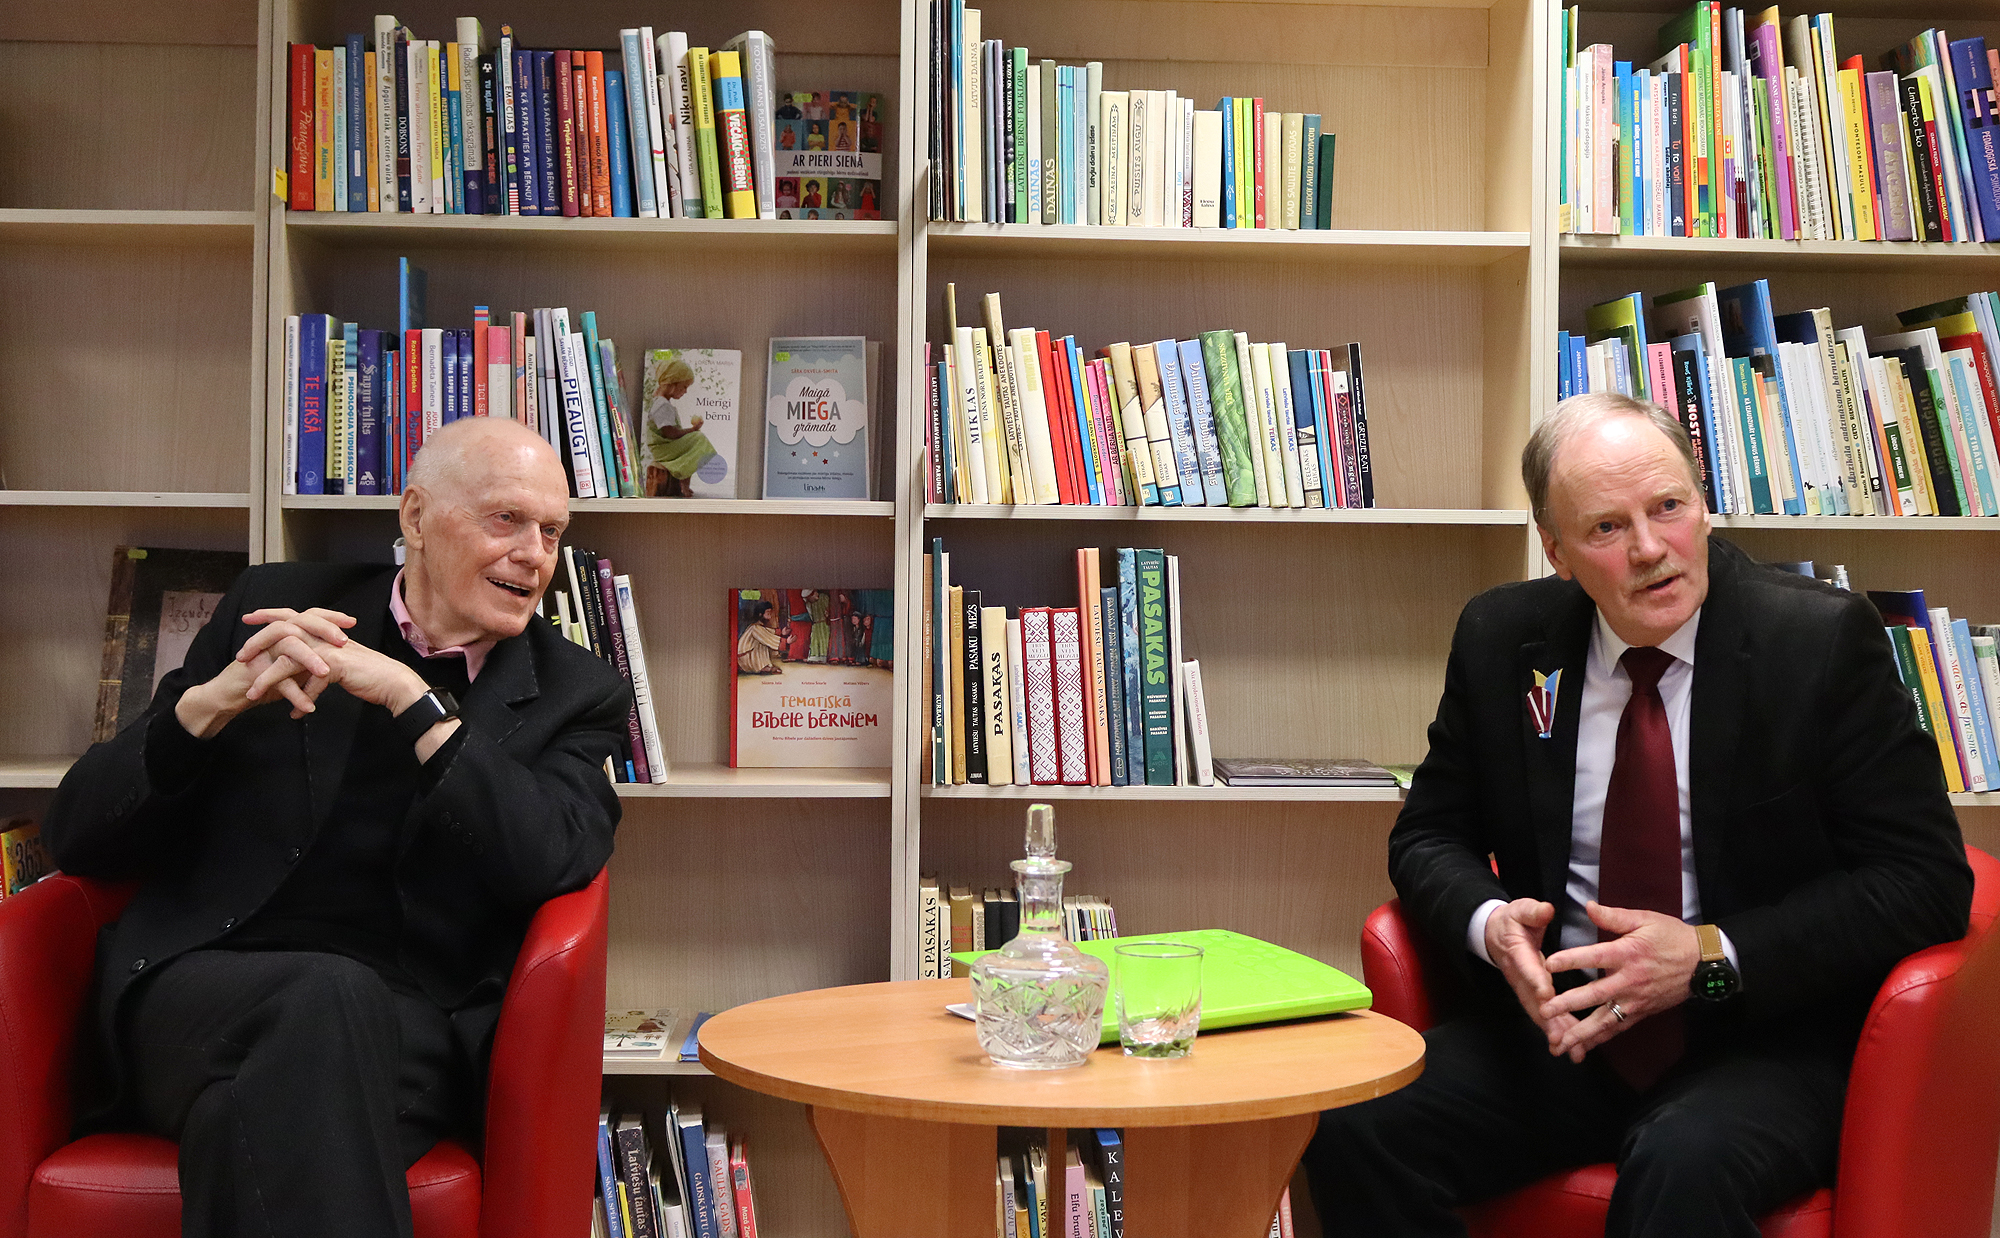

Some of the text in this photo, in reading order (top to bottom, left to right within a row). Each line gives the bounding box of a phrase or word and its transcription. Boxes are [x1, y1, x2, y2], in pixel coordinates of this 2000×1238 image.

[630, 56, 641, 84] DOMĀ
[754, 58, 763, 82] DOMĀ
[970, 42, 978, 71] DAINAS
[464, 48, 476, 167] Radošas personības rokasgrāmata
[632, 84, 641, 108] MANS
[677, 66, 691, 125] Niķu nav!
[756, 84, 764, 106] MANS
[521, 106, 530, 154] SAPRASTIES
[543, 107, 553, 154] SAPRASTIES
[634, 110, 645, 138] BĒRNS?
[756, 109, 767, 152] PUSAUDZIS?
[1015, 69, 1025, 193] LATVIEŠU BĒRNU FOLKLORA
[1907, 86, 1924, 148] Umberto Eko
[398, 116, 408, 154] DOBSONS
[729, 114, 747, 188] VECĀKI BĒRNI
[1982, 130, 1998, 172] PEDAGOĢISKĀ
[385, 162, 393, 184] vairāk
[522, 156, 530, 168] AR
[546, 156, 554, 168] AR
[792, 154, 864, 168] AR PIERI SIENĀ
[1620, 145, 1630, 204] DZIRKSTS
[1672, 140, 1682, 185] Tu to vari!
[1854, 123, 1866, 194] MONTESORI MAZULIS
[524, 170, 533, 201] BĒRNU?
[546, 170, 556, 202] BĒRNU?
[1030, 159, 1040, 212] DAINAS
[1045, 158, 1056, 215] DAINAS
[1287, 166, 1296, 198] SAULĪTE
[1286, 200, 1295, 217] KAD
[1614, 346, 1622, 372] JESPERS
[304, 376, 320, 394] TE,
[478, 383, 486, 400] TICI
[798, 386, 830, 403] Maigā
[932, 377, 940, 406] LATVIEŠU
[996, 344, 1016, 441] LATVIEŠU TAUTAS ANEKDOTES
[304, 396, 322, 433] IEKŠĀ
[346, 376, 354, 430] PSIHOLOĢIJA
[564, 378, 587, 458] PIEAUGT
[696, 397, 732, 410] Mierīgi
[705, 411, 731, 421] bērni
[788, 402, 841, 420] MIEGA
[1686, 404, 1700, 437] NOST
[793, 422, 837, 438] grāmata
[1268, 428, 1276, 452] TEIKAS
[1287, 428, 1295, 452] TEIKAS
[1962, 405, 1984, 470] MAZAIS TIRĀNS
[1360, 454, 1368, 474] RATI
[608, 604, 618, 624] FILIPS
[1093, 604, 1102, 647] LATVIEŠU
[1142, 571, 1166, 684] PASAKAS
[966, 604, 978, 670] PASAKU MEŽS
[991, 652, 1004, 736] PASAKAS
[1969, 678, 1986, 726] Mazais runā
[752, 709, 878, 728] Bībele bērniem
[1958, 716, 1979, 760] prasmes
[924, 898, 936, 964] PASAKAS
[627, 1148, 646, 1230] Latviešu tautas
[694, 1172, 709, 1230] GADSKĀRTU
[713, 1159, 731, 1232] SAULES GADS
[1070, 1193, 1080, 1212] Elfu
[1006, 1192, 1015, 1227] KRIEVU
